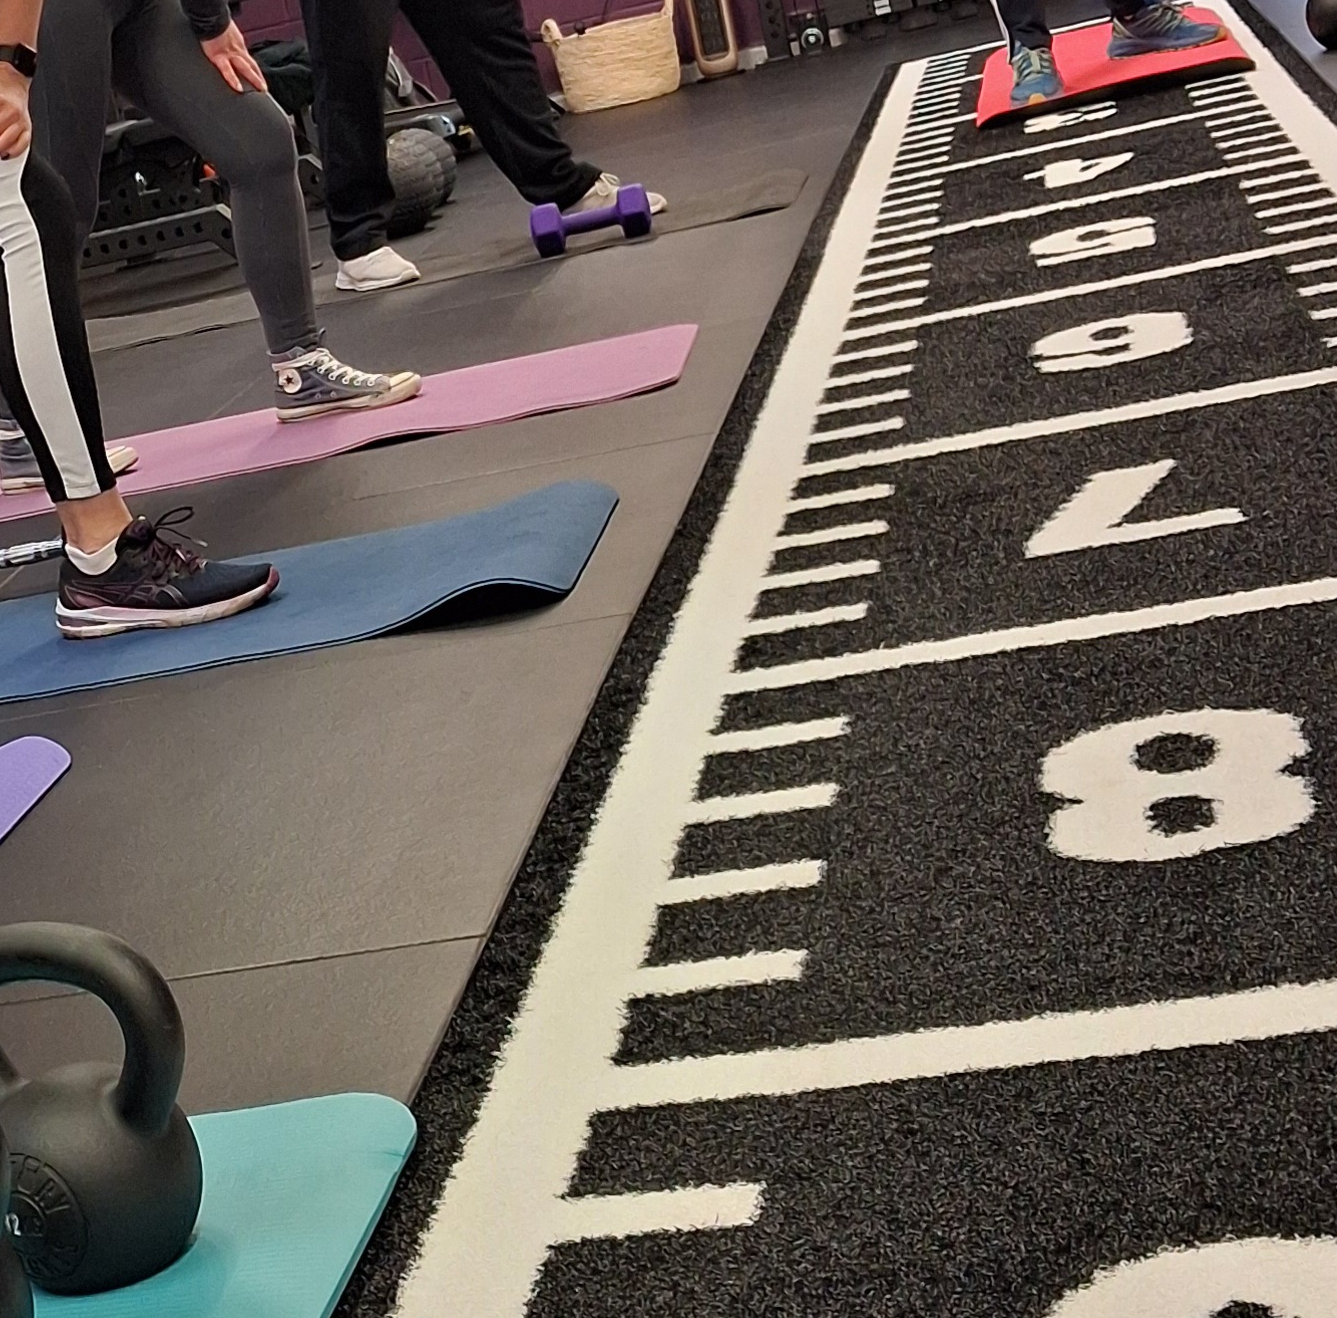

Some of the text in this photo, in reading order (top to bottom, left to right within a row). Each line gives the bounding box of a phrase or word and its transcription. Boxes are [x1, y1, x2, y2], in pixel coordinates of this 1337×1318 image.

[1022, 151, 1135, 189] 4
[1029, 216, 1156, 267] 5
[1040, 707, 1316, 862] 8
